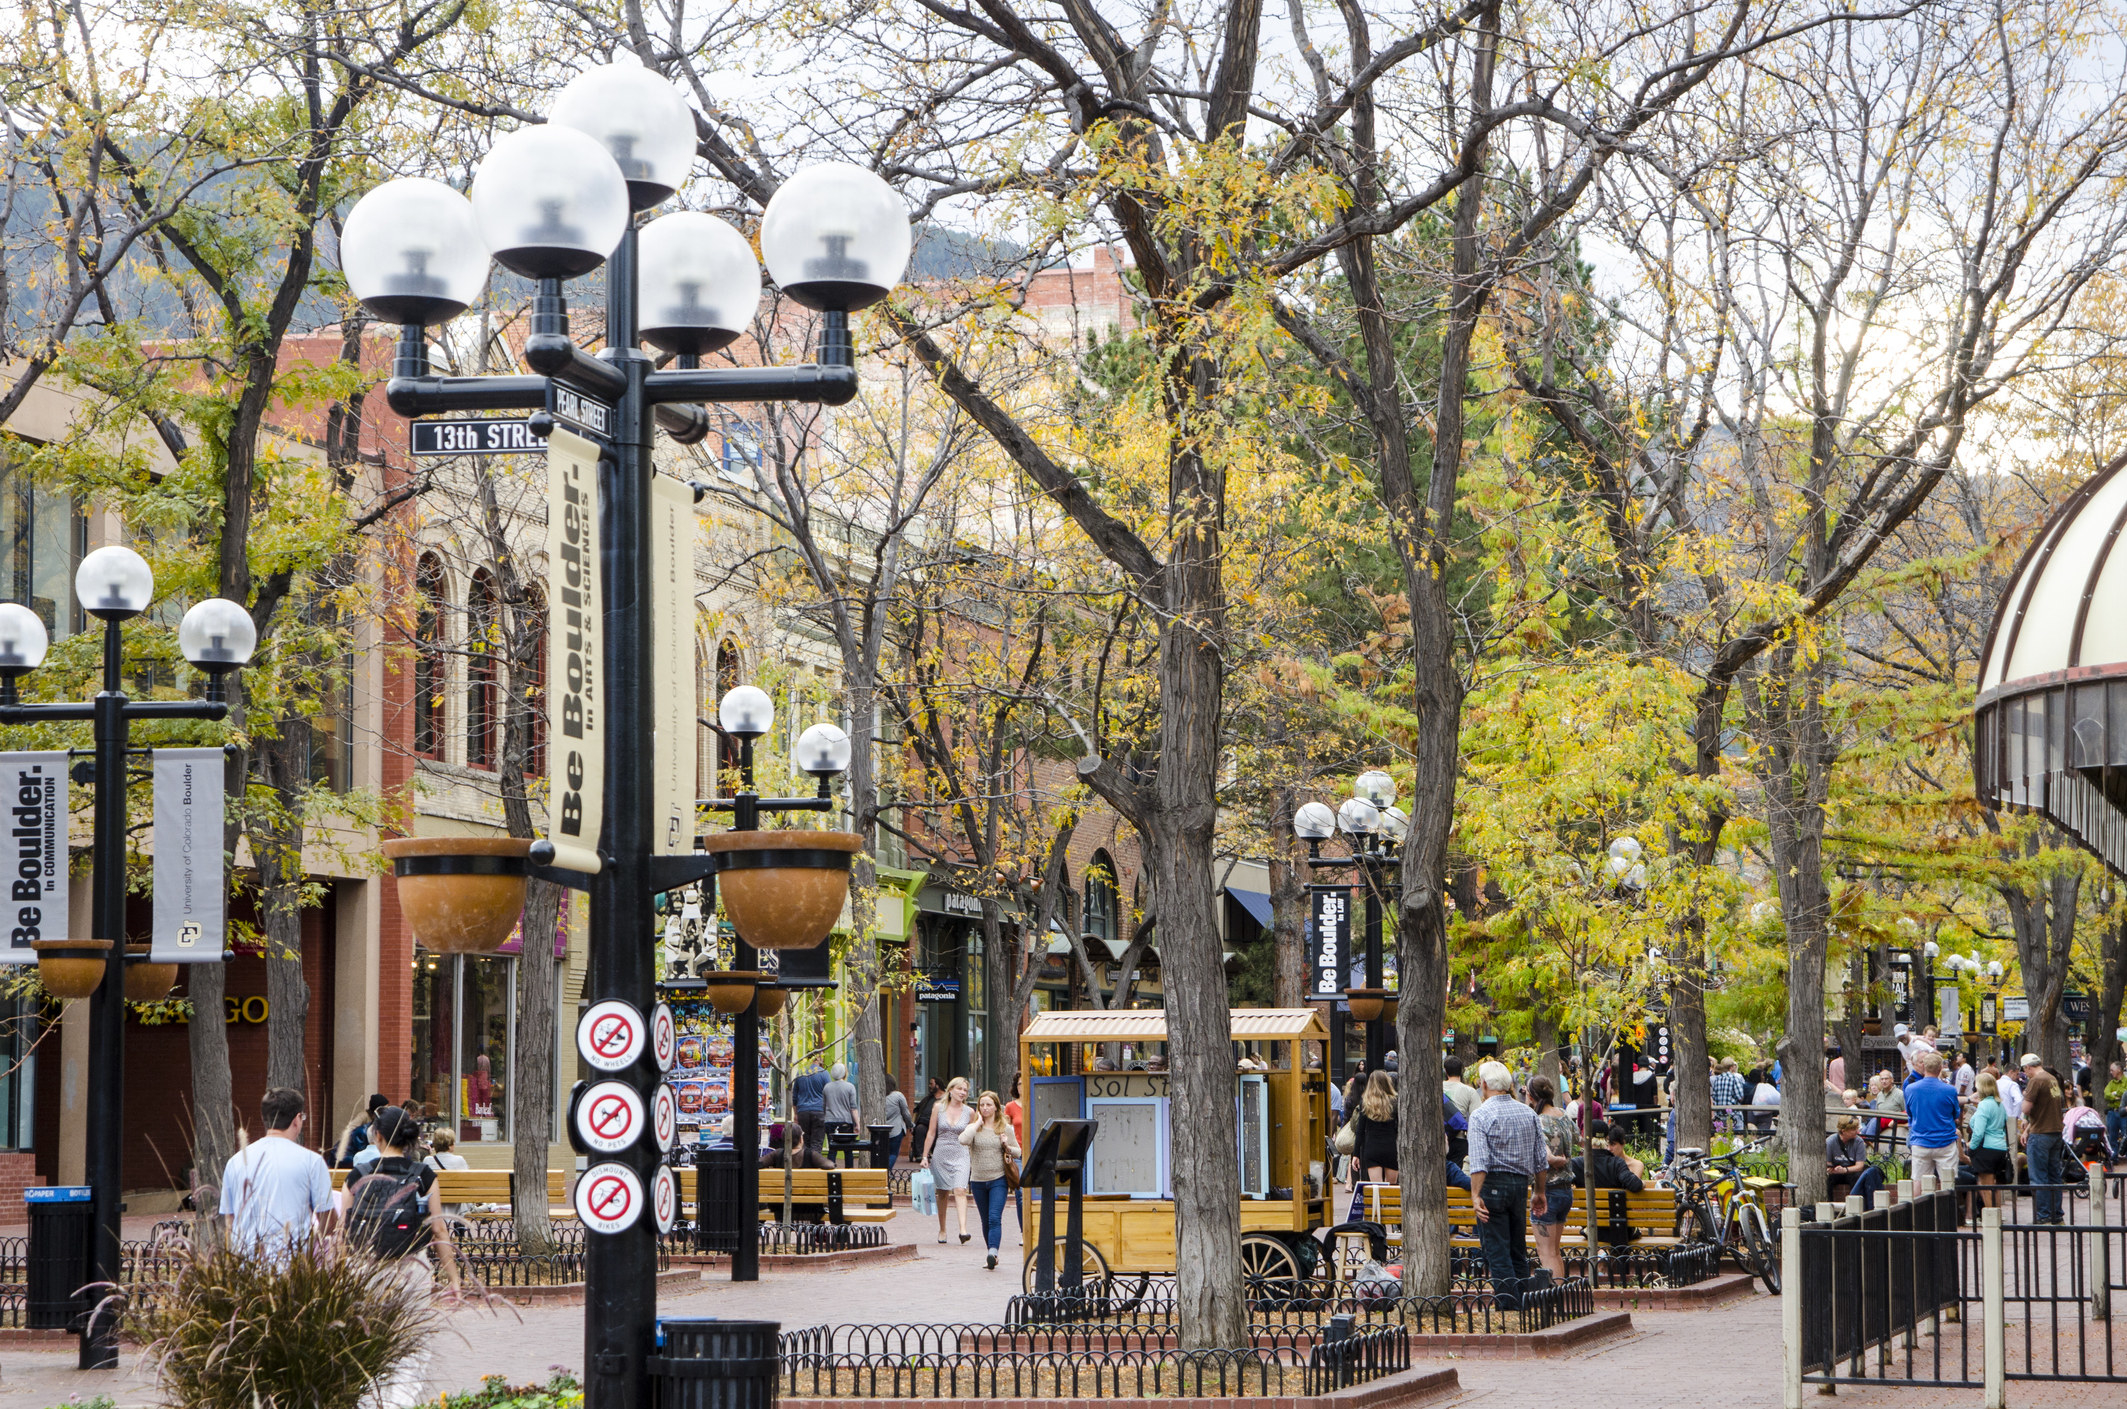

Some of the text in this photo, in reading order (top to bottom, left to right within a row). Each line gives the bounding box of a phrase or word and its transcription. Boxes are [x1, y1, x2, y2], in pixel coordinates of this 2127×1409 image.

[557, 387, 606, 432] PEARL STREET
[434, 426, 478, 449] 13th
[582, 492, 593, 730] In ARTS & SCIENCES
[560, 464, 583, 836] Be Boulder.
[671, 680, 677, 699] of
[44, 777, 55, 891] In COMMUNICATION
[183, 763, 194, 915] University of Colorado Boulder
[11, 765, 42, 948] Be Boulder.
[1319, 892, 1337, 993] Be Boulder.
[919, 992, 955, 1001] patagonia
[1864, 1039, 1897, 1048] Eyewe
[591, 1053, 632, 1067] NO WHEELS
[1090, 1077, 1170, 1097] Sol St
[593, 1138, 626, 1148] NO PETS
[591, 1166, 628, 1178] DISMOUNT
[34, 1190, 54, 1198] PAPER
[598, 1221, 620, 1230] BIKES
